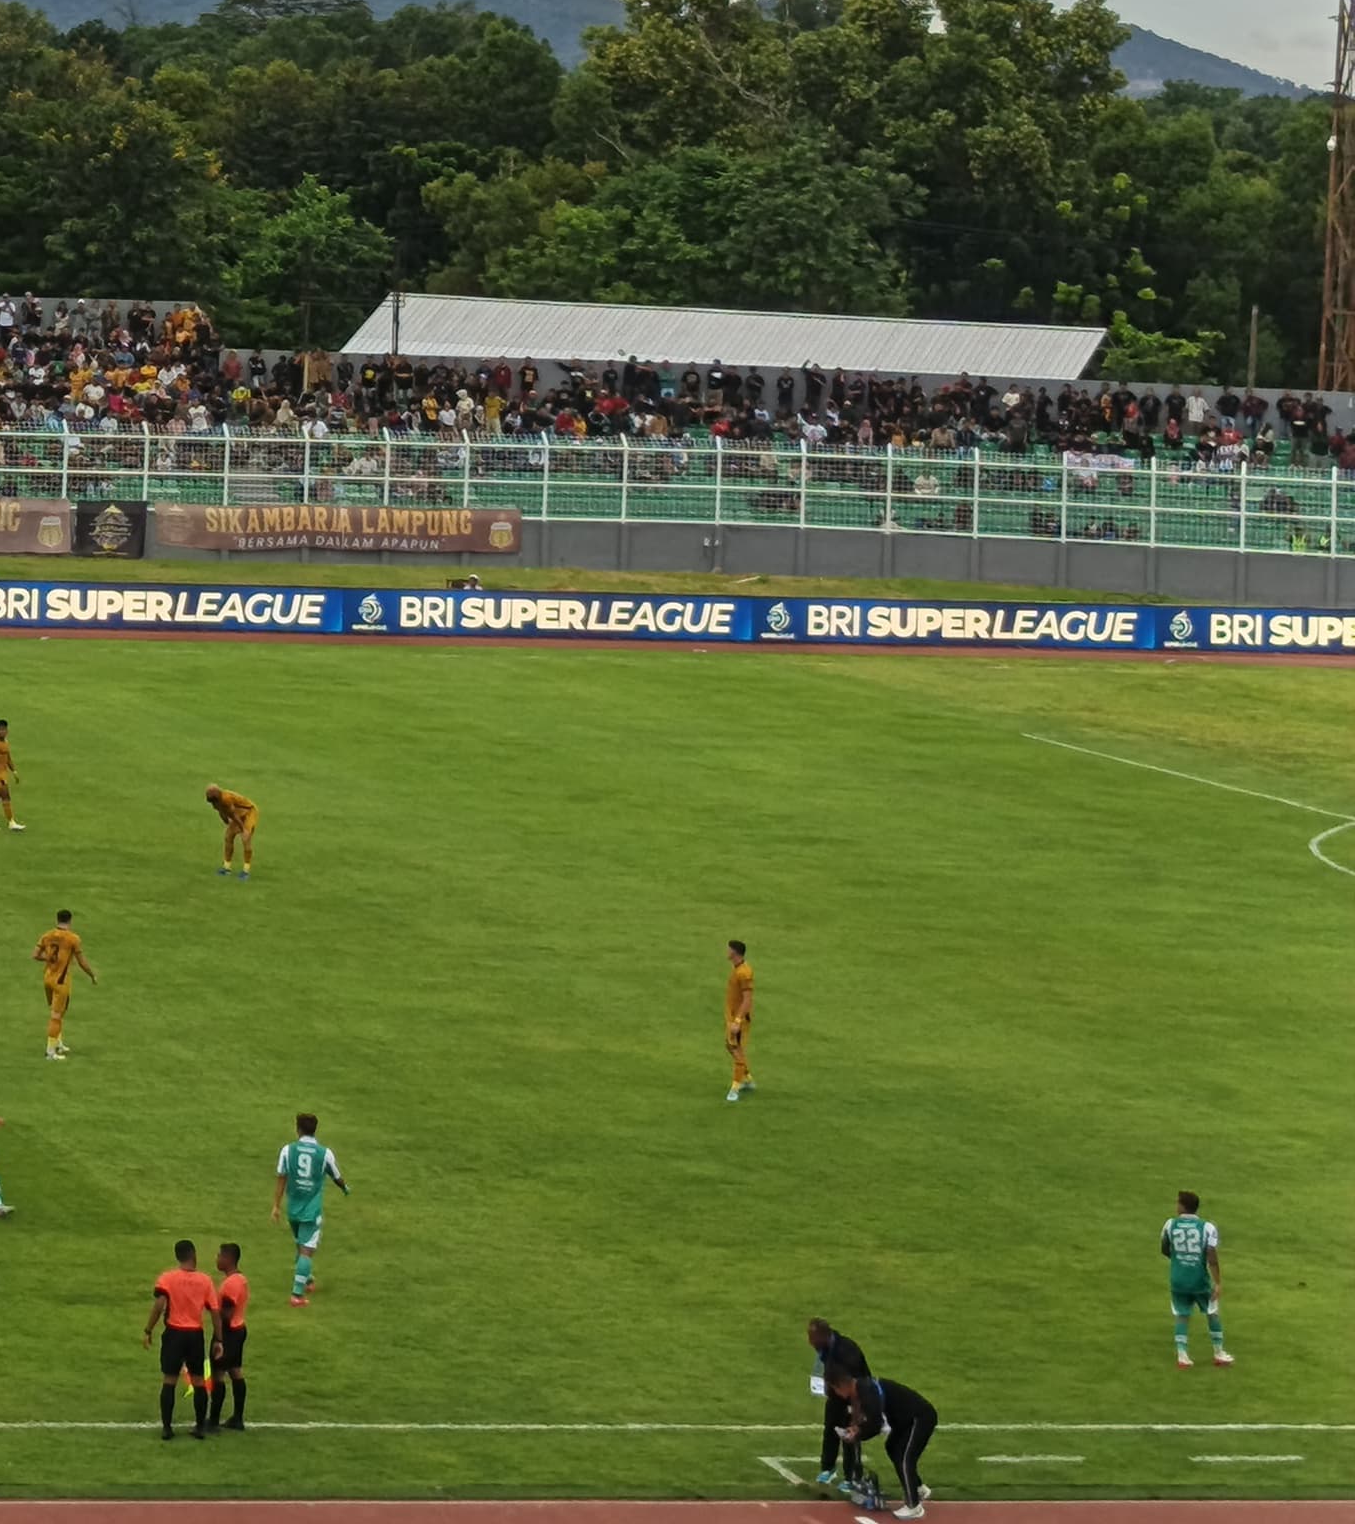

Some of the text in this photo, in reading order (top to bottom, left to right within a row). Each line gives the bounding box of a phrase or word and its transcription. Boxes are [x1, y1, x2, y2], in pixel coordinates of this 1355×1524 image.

[361, 509, 473, 536] LAMPUNG
[400, 596, 454, 628] BRI
[807, 605, 861, 638] BRI
[1210, 613, 1263, 645] BRI
[297, 1153, 313, 1178] 9
[1172, 1228, 1202, 1254] 22
